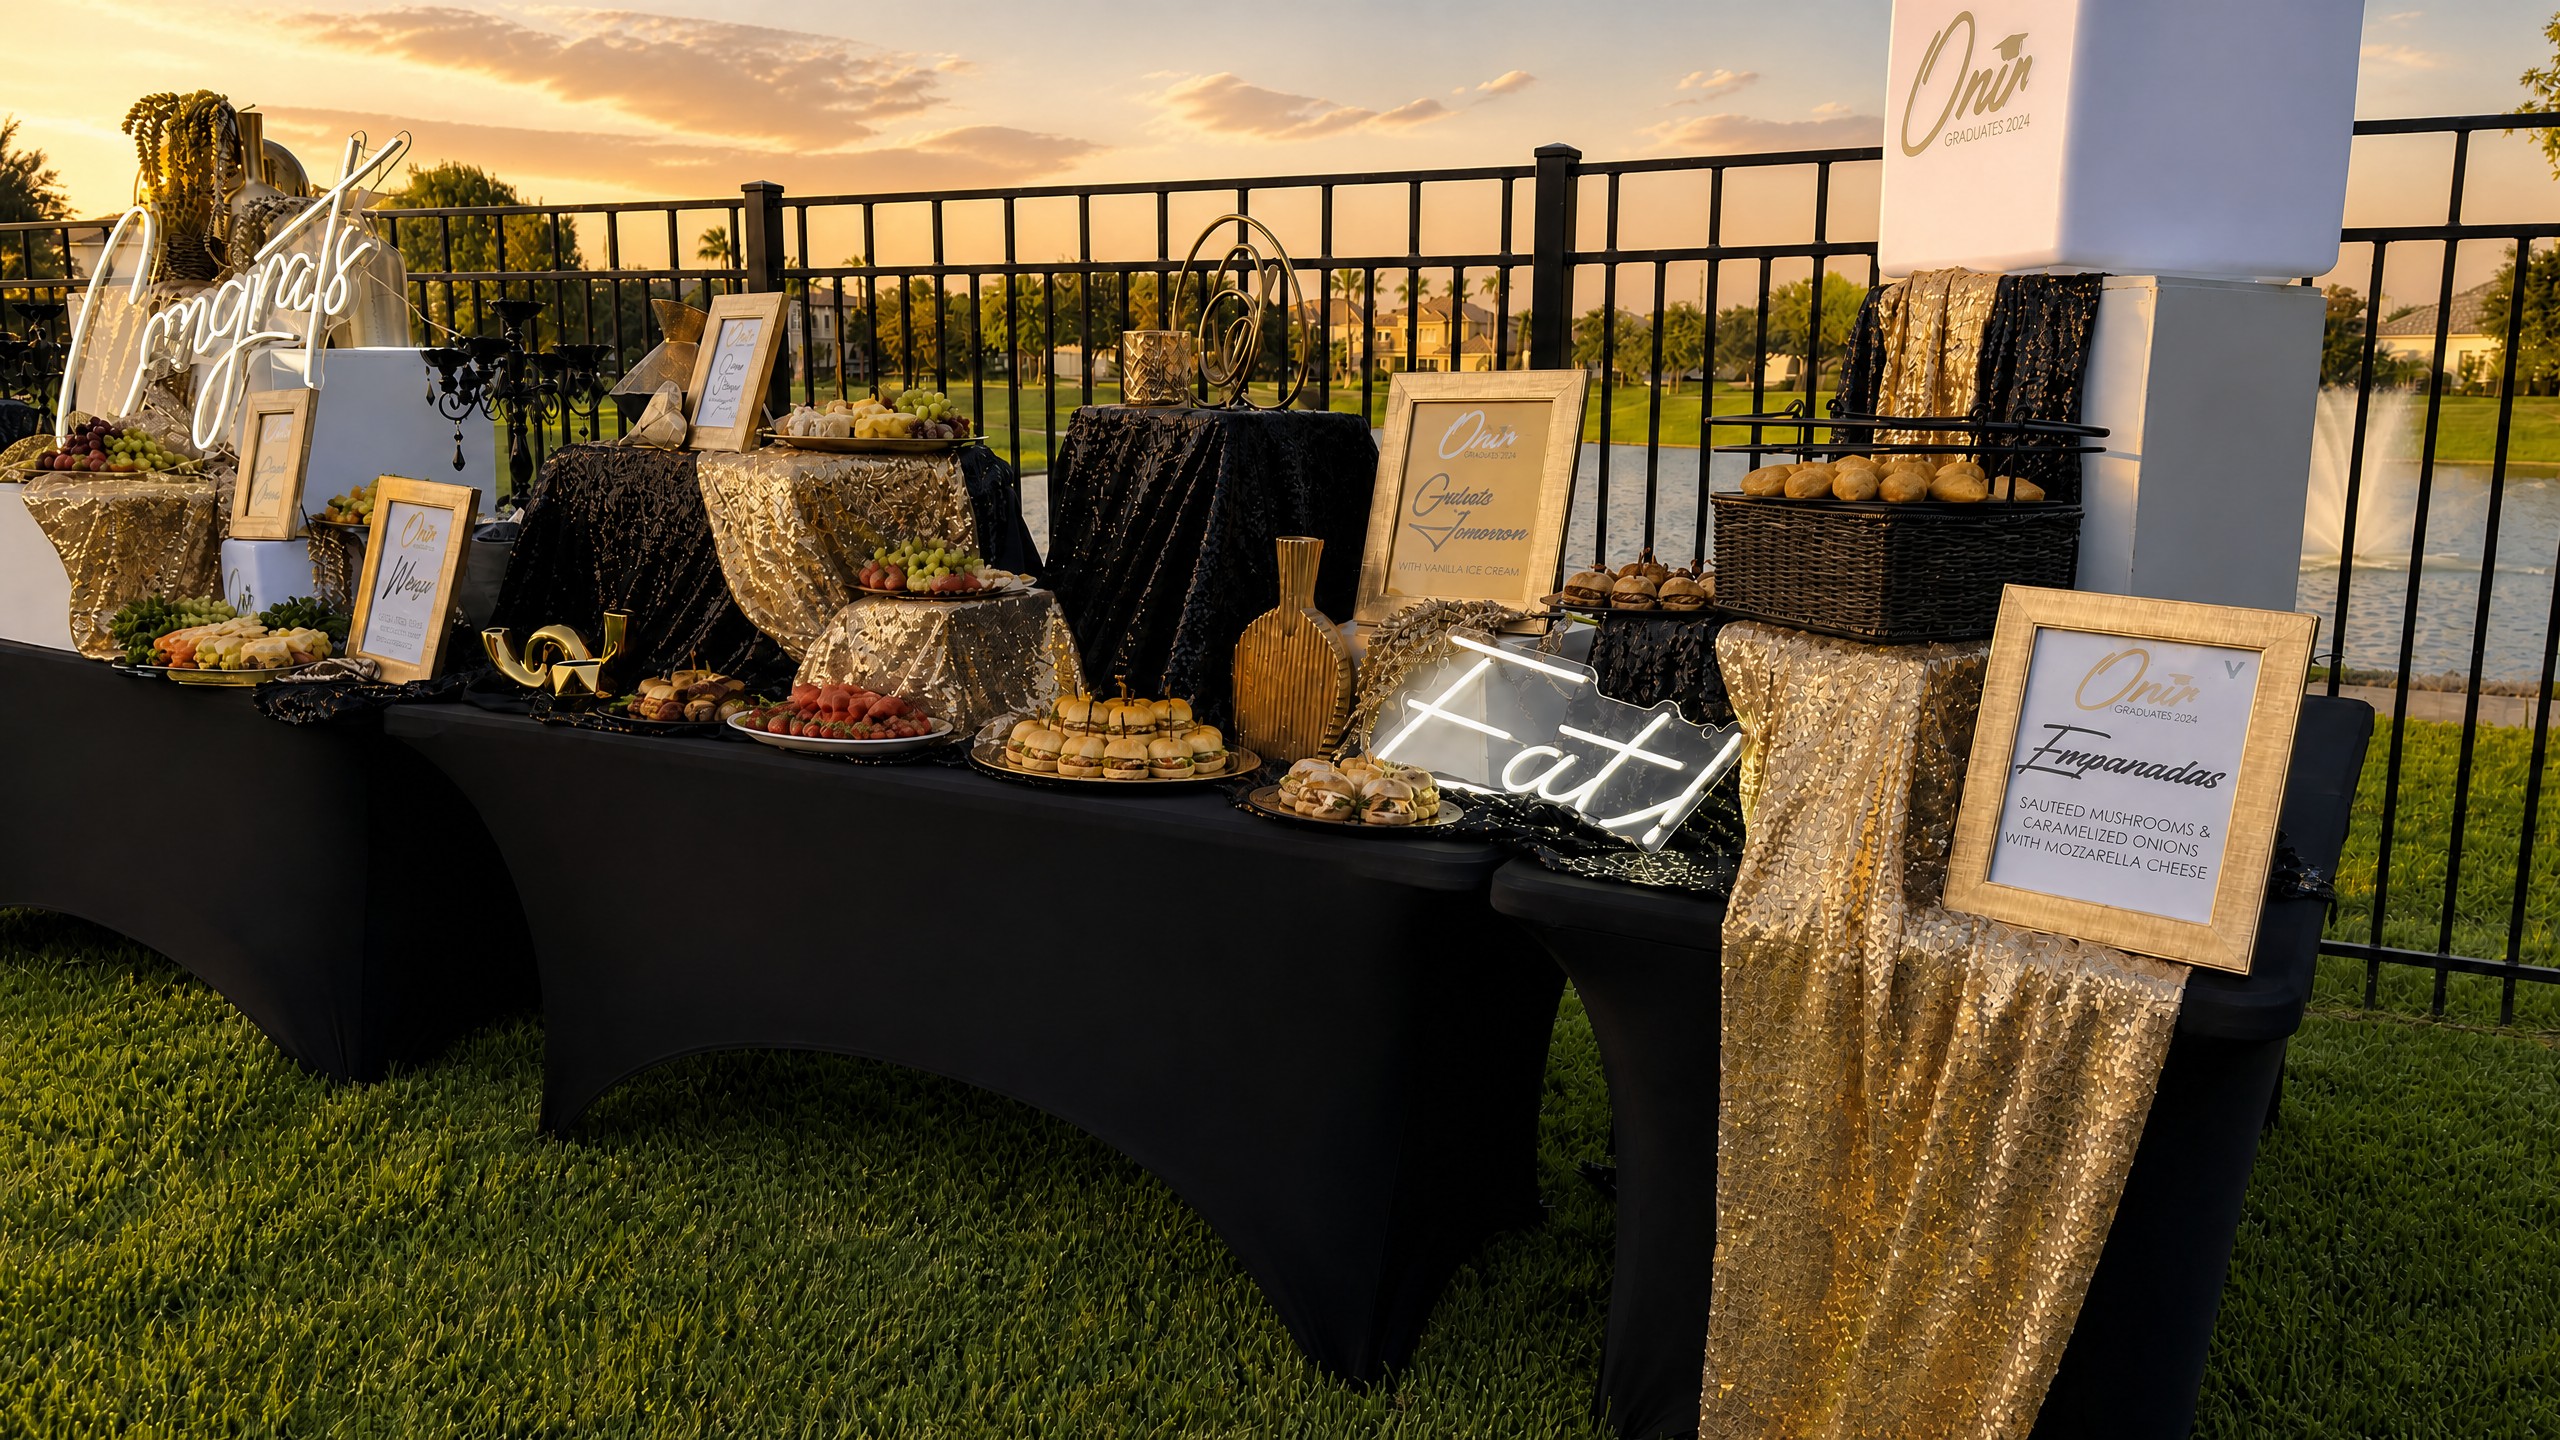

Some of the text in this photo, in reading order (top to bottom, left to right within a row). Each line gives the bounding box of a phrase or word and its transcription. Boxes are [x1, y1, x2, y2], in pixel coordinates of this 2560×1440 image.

[1901, 11, 2033, 157] Onir
[1944, 113, 2031, 147] GRADUATES 2024
[1398, 561, 1520, 576] WITH VANILLA ICE CREAM
[2074, 648, 2201, 711] Onir
[2114, 704, 2198, 724] GRADUATES 2024
[2015, 723, 2227, 789] Empanadas
[2019, 796, 2211, 838] SAUTEED MUSHROOMS &
[2022, 816, 2199, 858] CARAMELIZED ONIONS
[2004, 831, 2208, 880] WITH MOZZARELLA CHEESE
